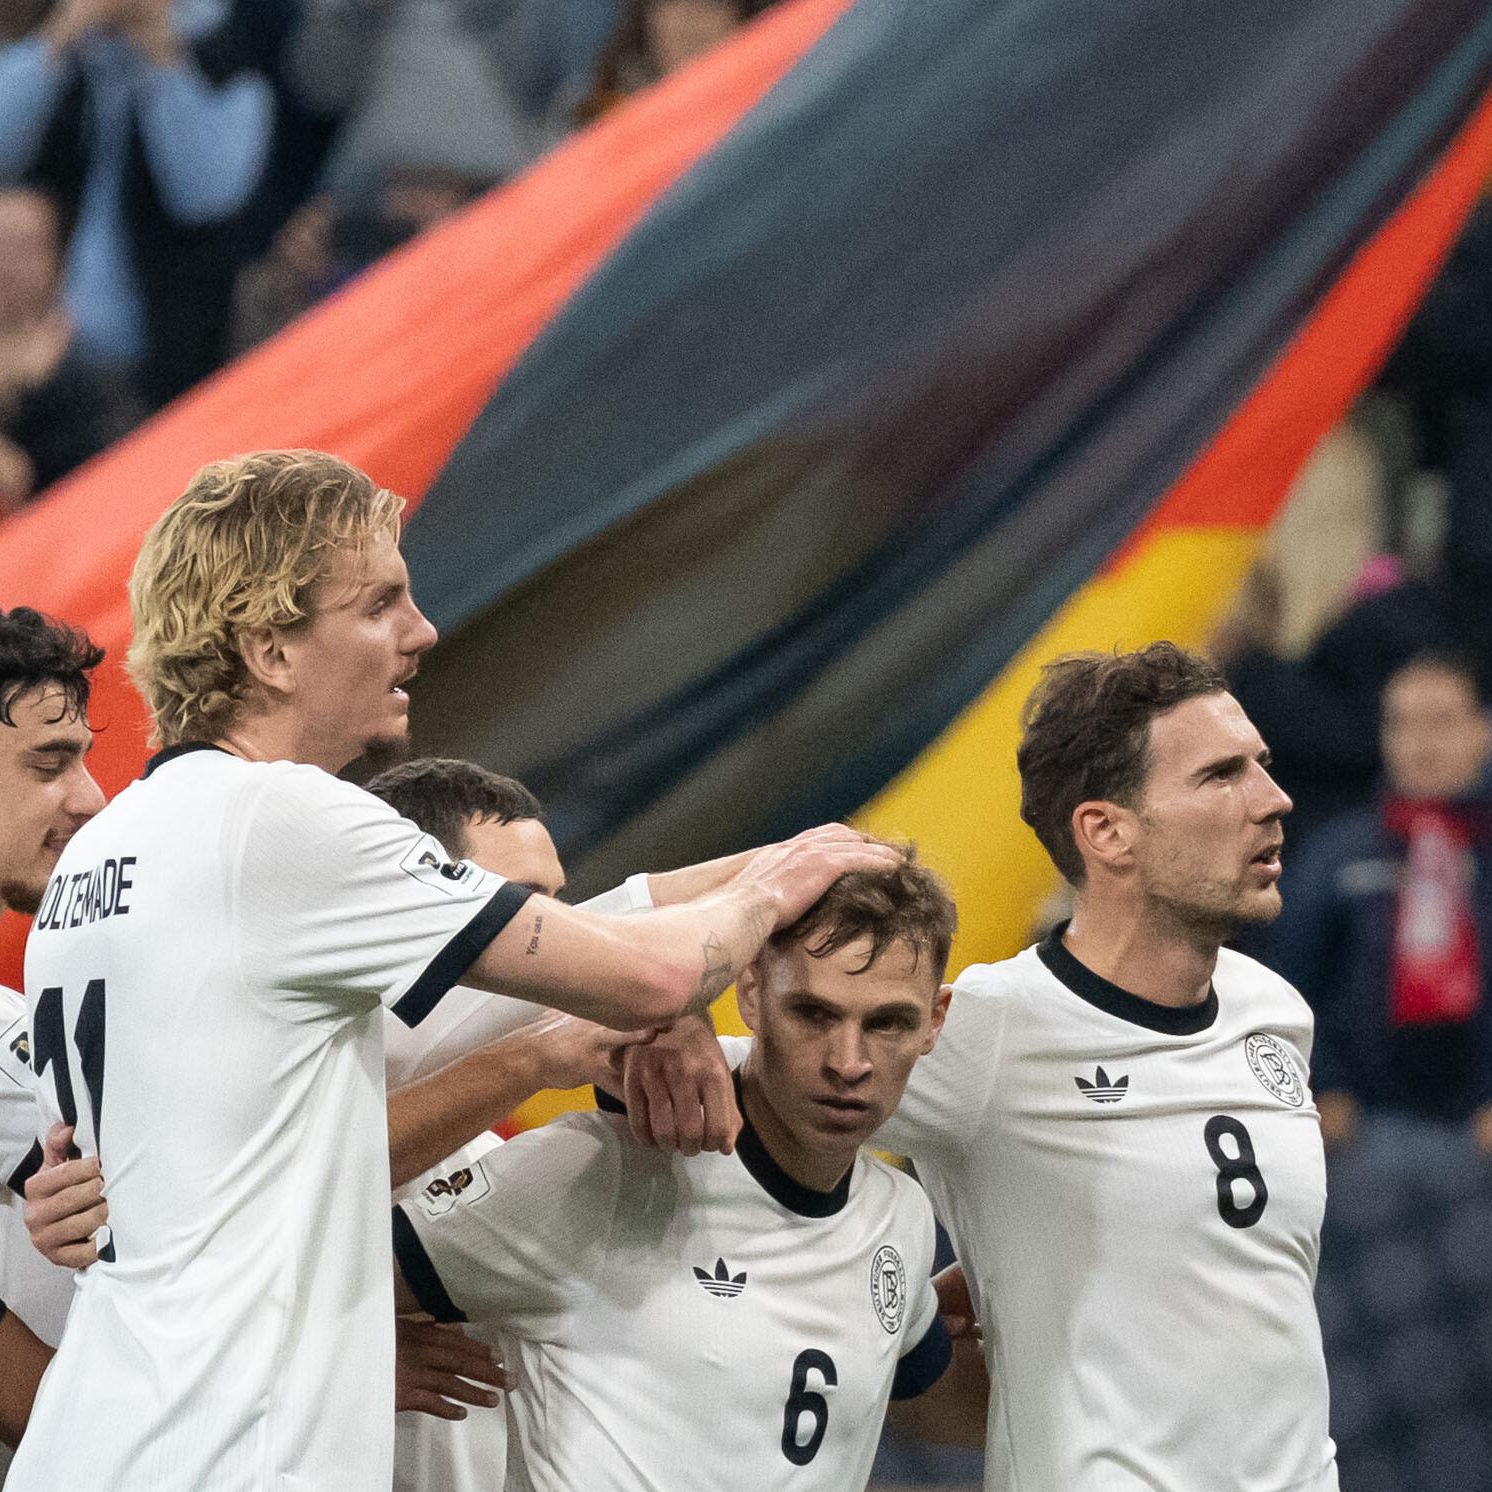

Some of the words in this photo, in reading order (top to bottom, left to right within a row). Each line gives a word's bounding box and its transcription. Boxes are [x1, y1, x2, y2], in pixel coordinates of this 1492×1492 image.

[33, 856, 136, 930] OLTEMADE
[33, 978, 115, 1262] 11
[1204, 1114, 1269, 1229] 8
[780, 1347, 838, 1467] 6
